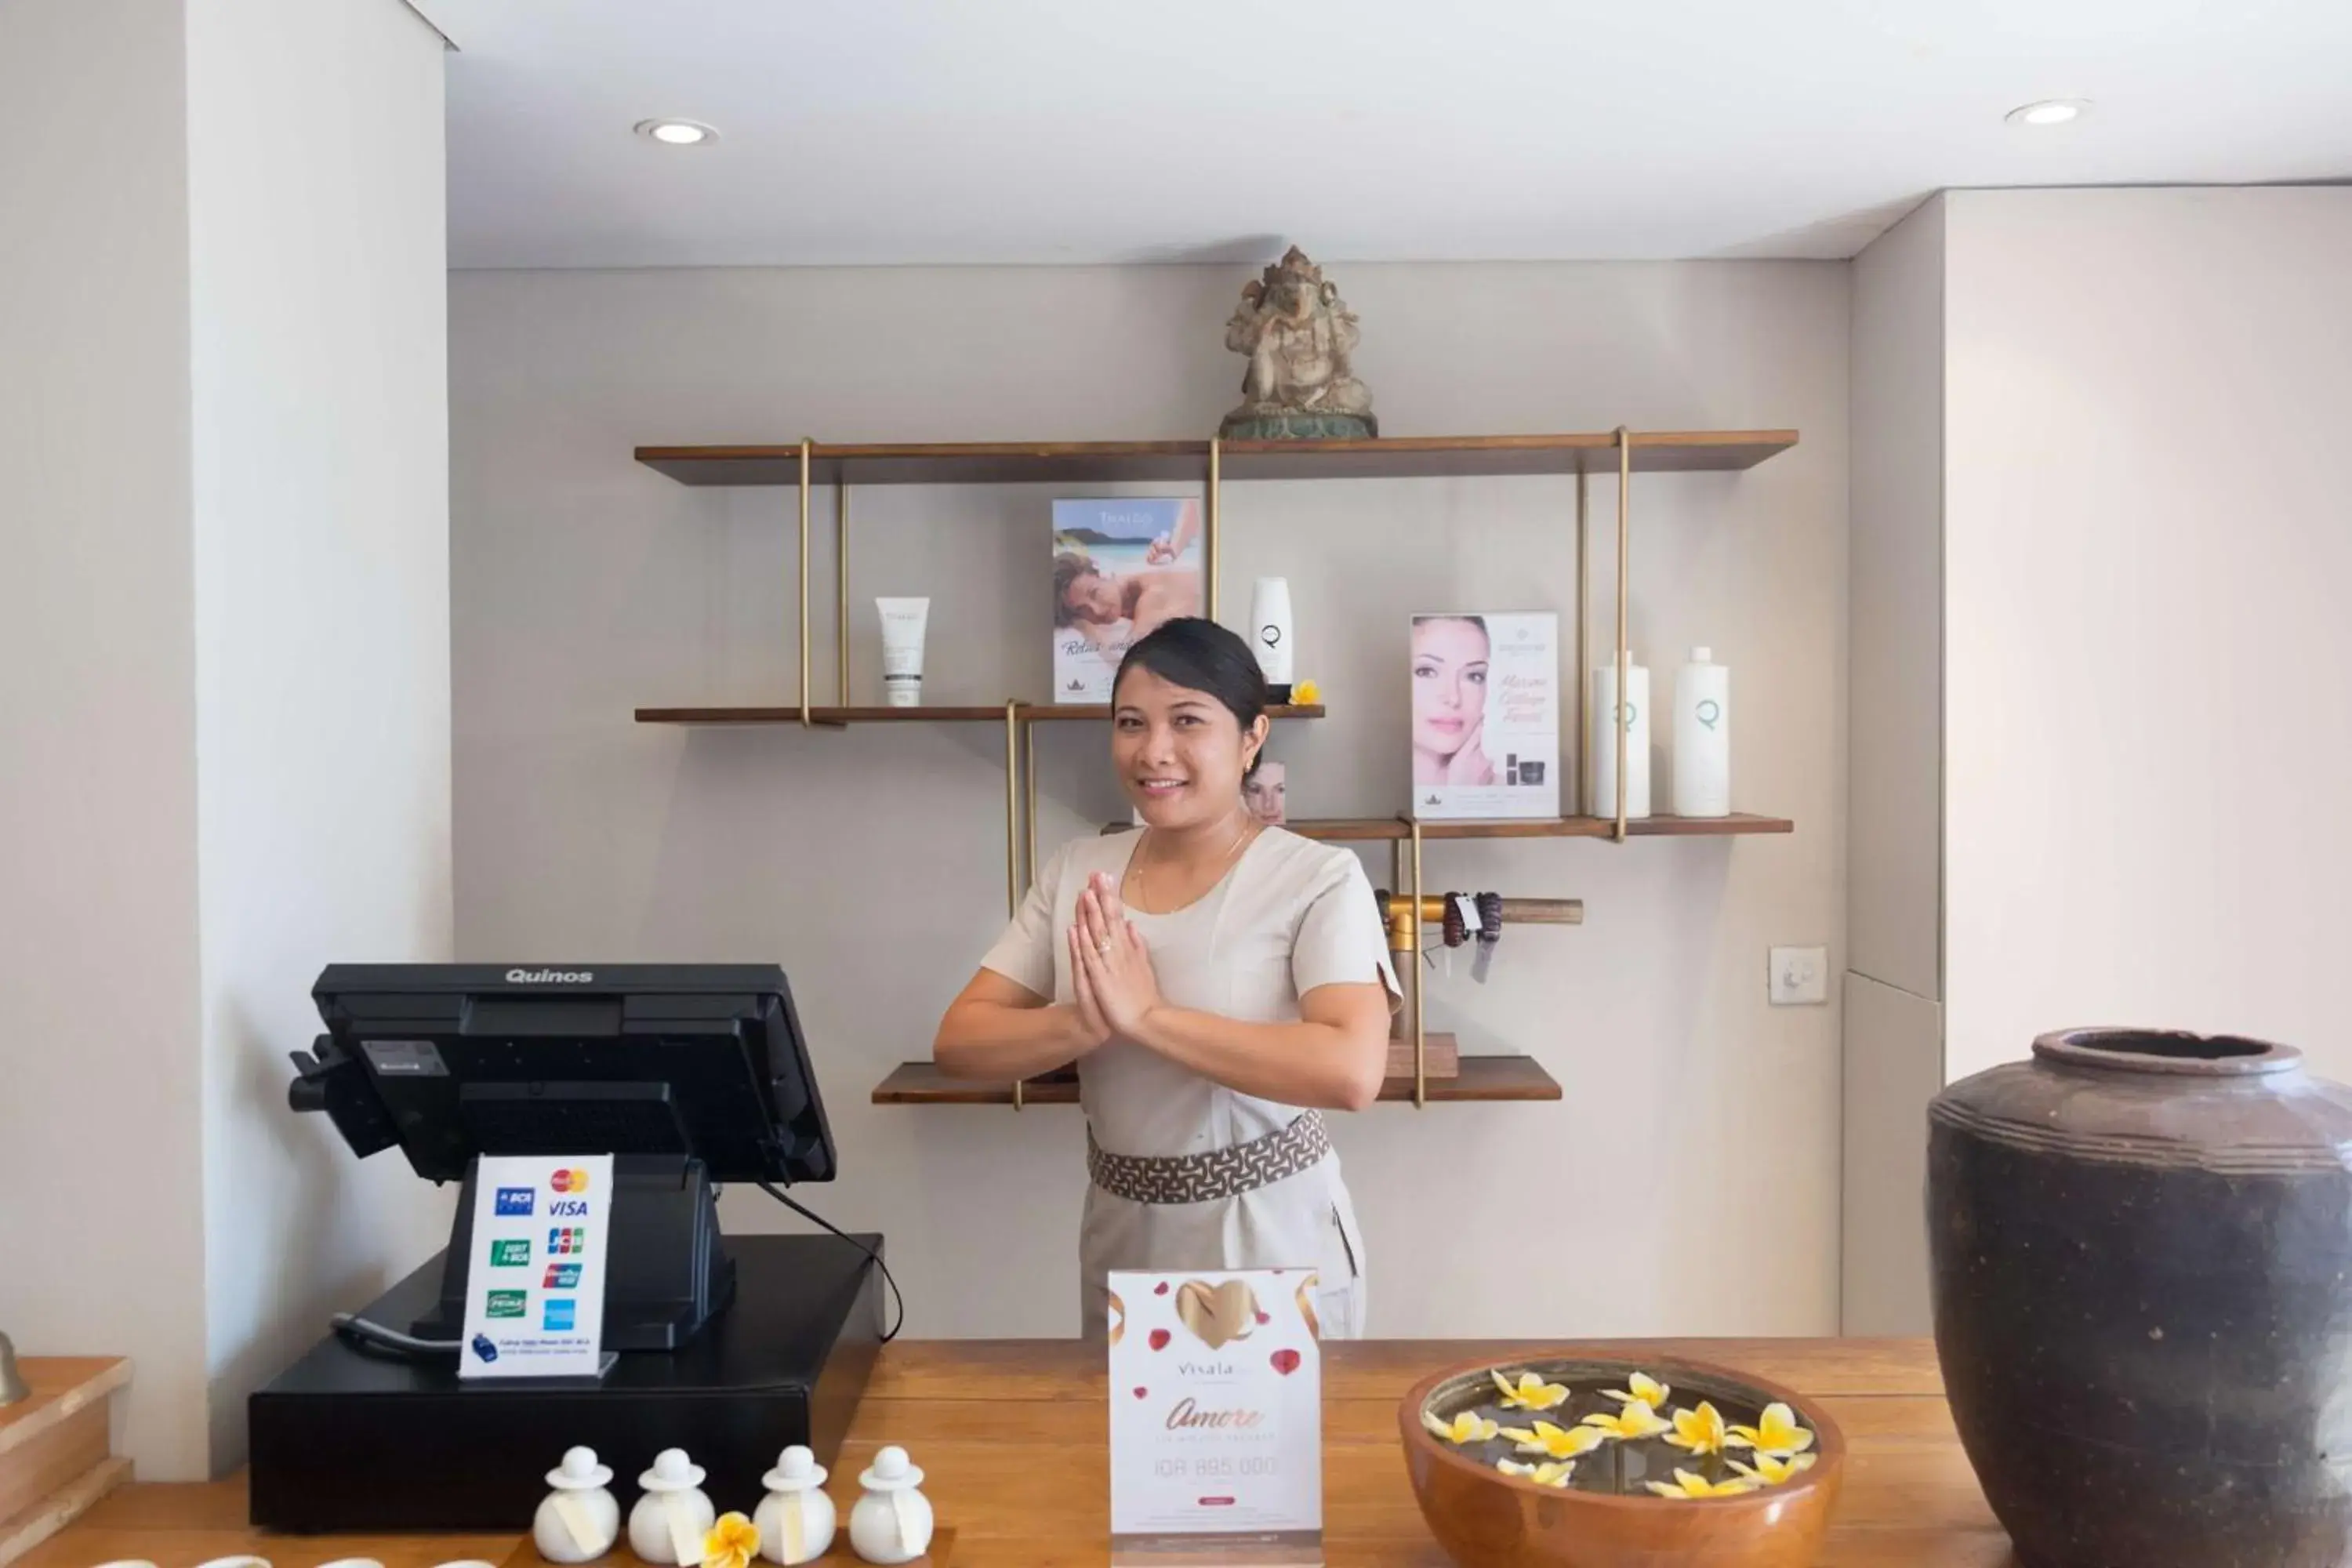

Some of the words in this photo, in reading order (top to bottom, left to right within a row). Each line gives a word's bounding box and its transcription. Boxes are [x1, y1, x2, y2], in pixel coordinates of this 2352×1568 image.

[506, 968, 593, 984] Quinos
[550, 1201, 588, 1216] VISA
[1166, 1397, 1266, 1430] Amore
